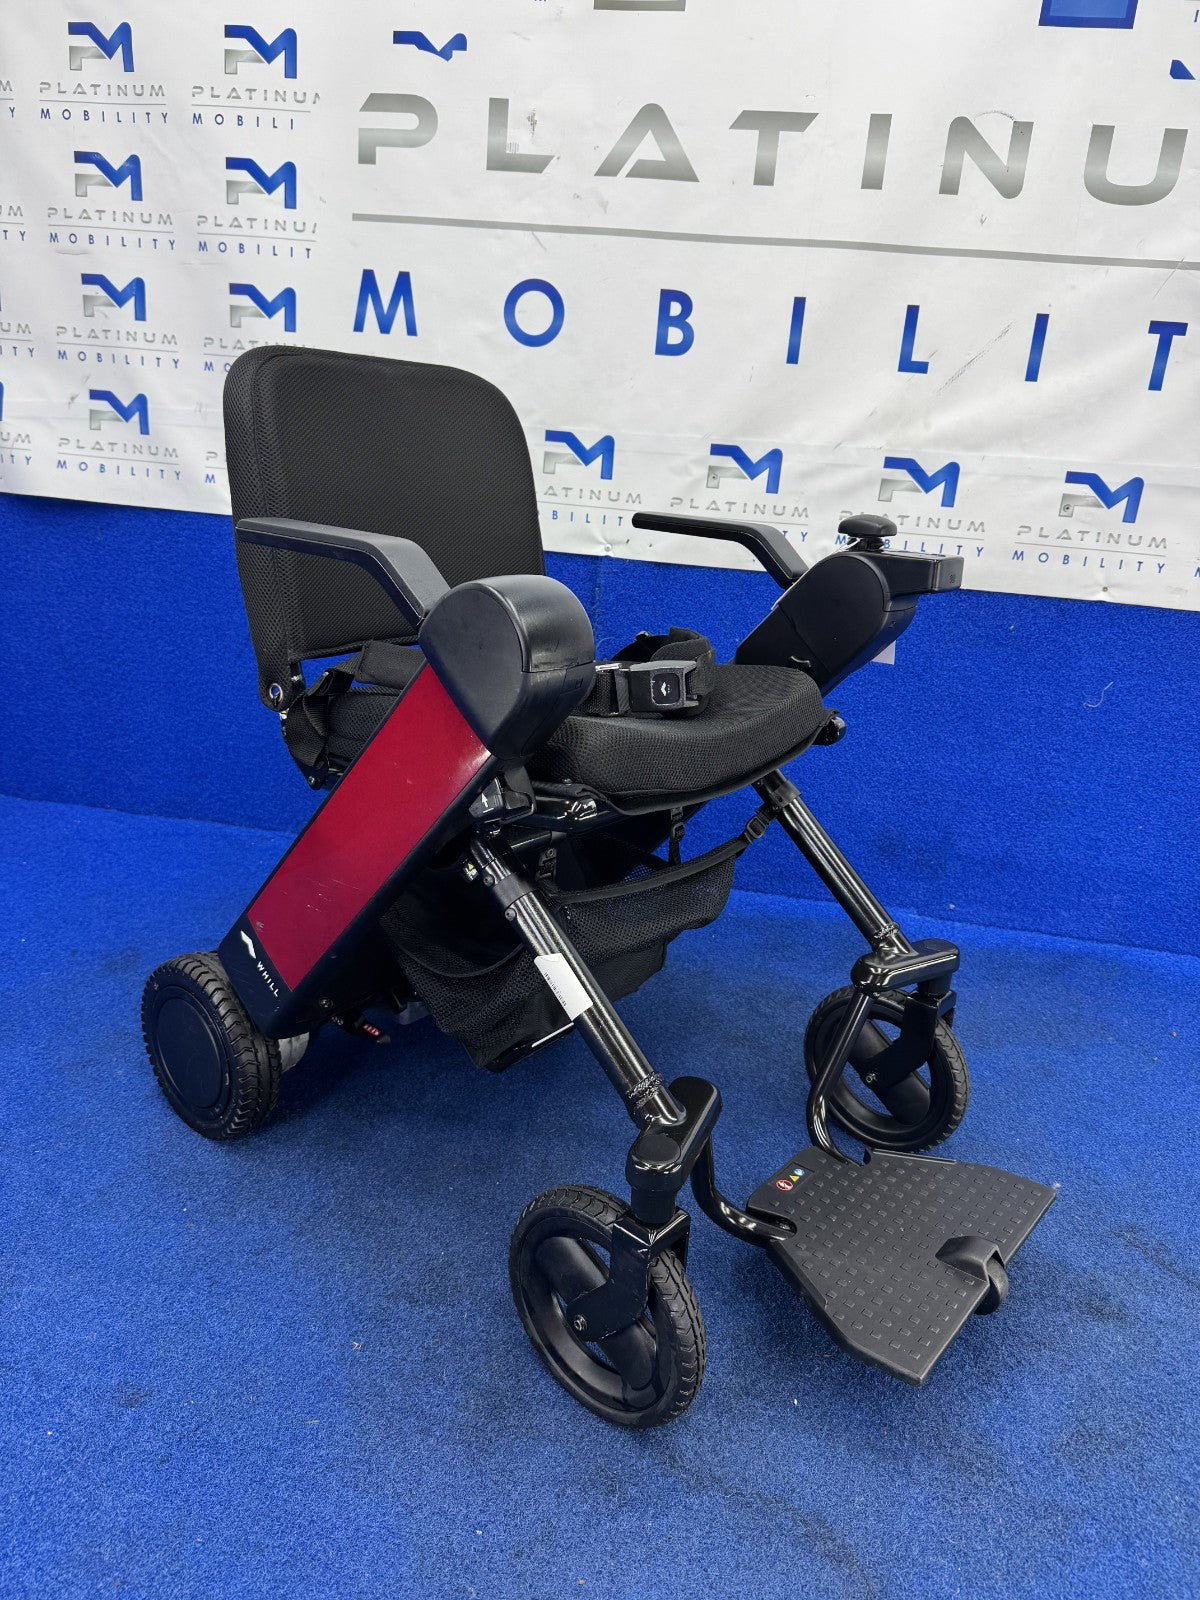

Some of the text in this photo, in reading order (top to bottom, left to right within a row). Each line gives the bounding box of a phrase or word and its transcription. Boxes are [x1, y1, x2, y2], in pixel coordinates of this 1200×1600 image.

[40, 82, 165, 96] PLATINUM
[41, 108, 168, 124] MOBILITY
[358, 93, 1188, 206] PLATINU
[48, 207, 173, 225] PLATINUM
[49, 232, 175, 250] MOBILITY
[198, 241, 311, 258] MOBILIT
[56, 326, 177, 345] PLATINUM
[353, 268, 1188, 391] MOBILIT
[58, 350, 180, 369] MOBILITY
[58, 437, 178, 458] PLATINUM
[57, 460, 181, 480] MOBILITY
[544, 486, 641, 504] ATINUM
[552, 508, 624, 526] BILIT
[670, 497, 808, 518] PLATINUM
[839, 510, 985, 532] PTINUM
[1017, 522, 1167, 549] PLATINUM
[835, 535, 984, 557] MBILITY
[1012, 550, 1165, 573] MOBILITY
[258, 962, 278, 996] WHILL
